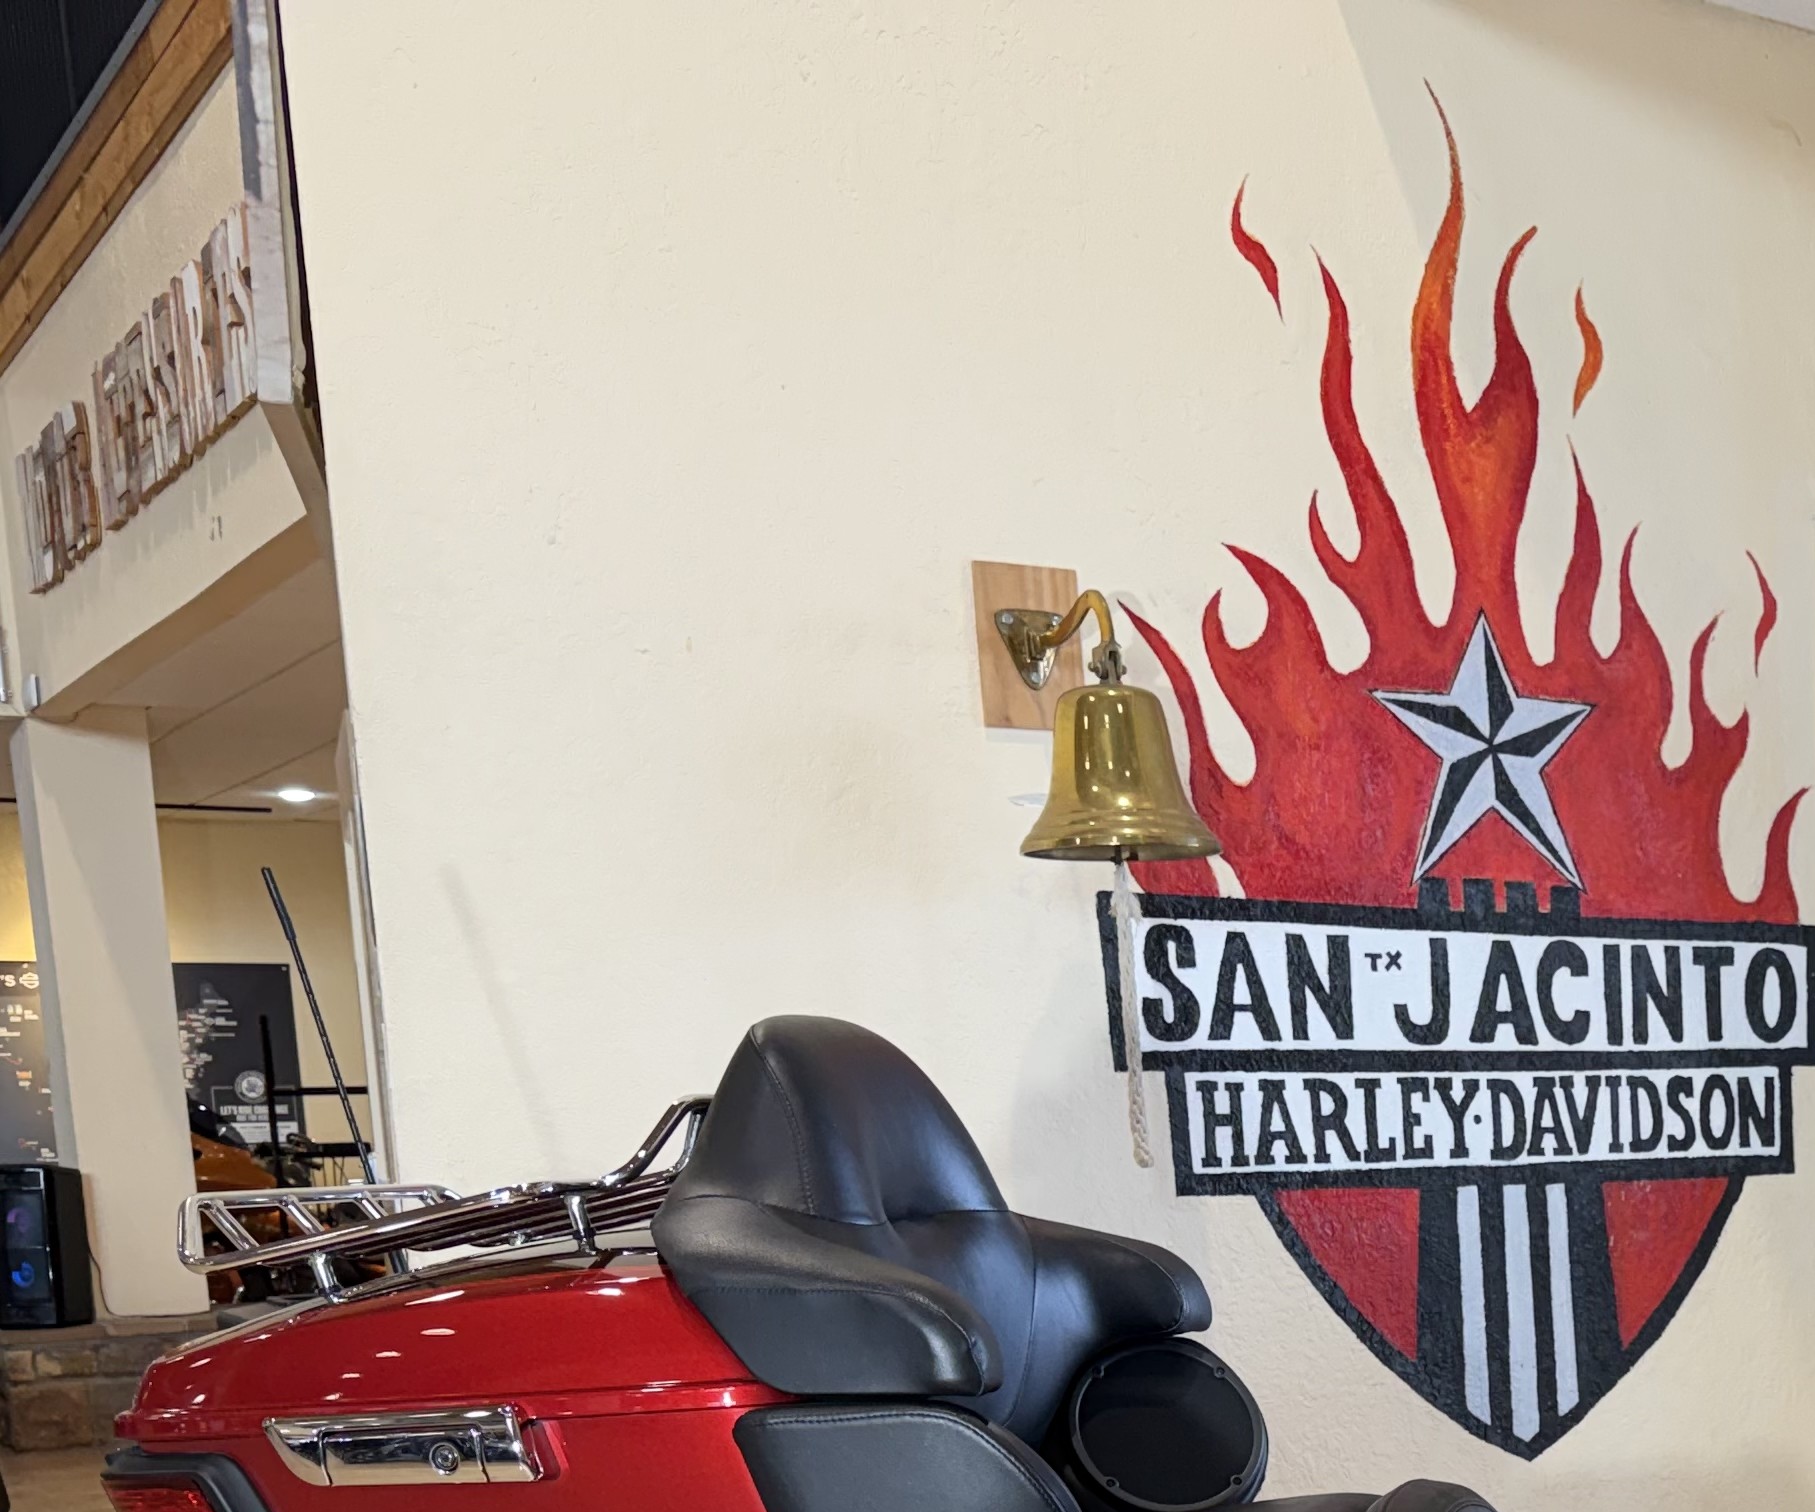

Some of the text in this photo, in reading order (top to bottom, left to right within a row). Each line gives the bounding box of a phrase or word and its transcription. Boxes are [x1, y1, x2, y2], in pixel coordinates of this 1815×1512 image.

[1141, 923, 1797, 1046] SAN TX JACINTO
